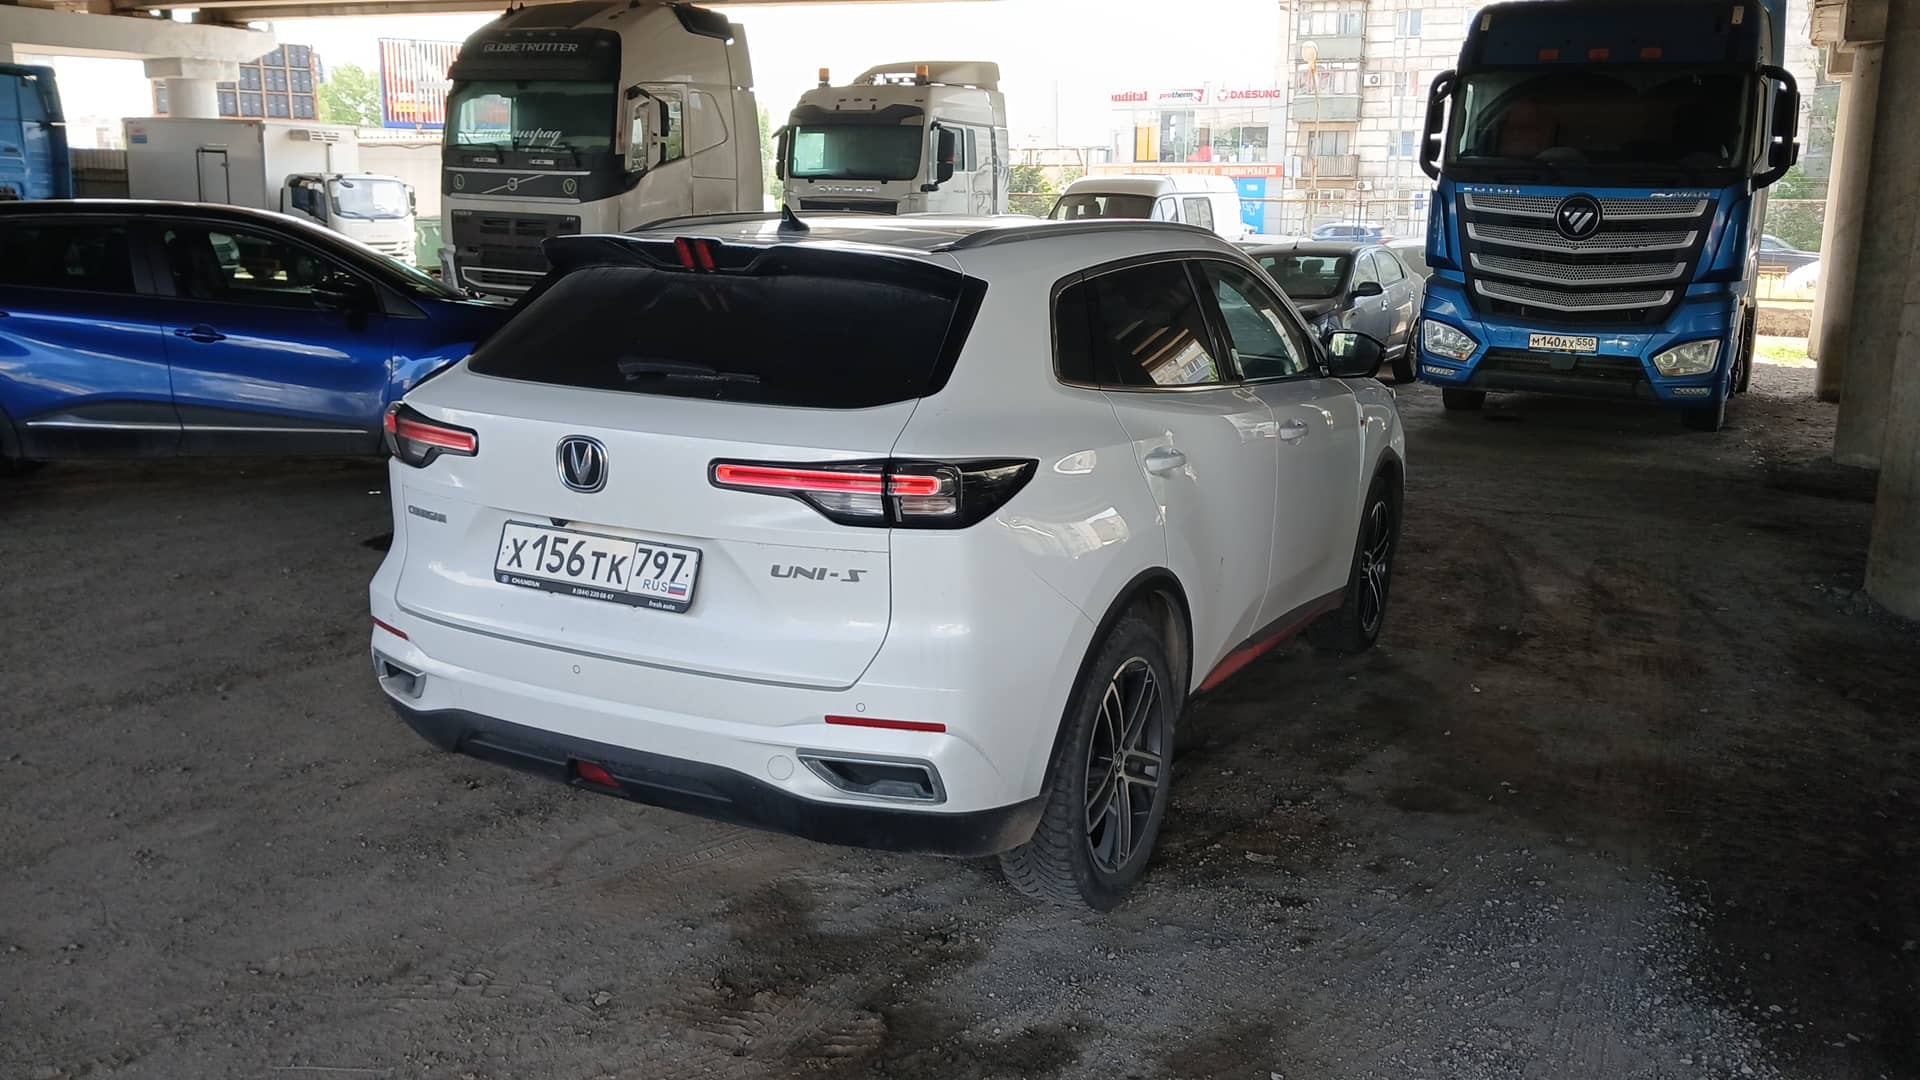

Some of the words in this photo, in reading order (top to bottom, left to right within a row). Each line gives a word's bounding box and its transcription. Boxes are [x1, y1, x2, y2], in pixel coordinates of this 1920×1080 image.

[483, 42, 578, 53] GLOBETROTTER
[1230, 89, 1281, 99] DAESUNG
[507, 535, 628, 584] Х156ТК
[635, 548, 687, 582] 797
[771, 564, 867, 582] UNI-S
[643, 578, 668, 593] RUS
